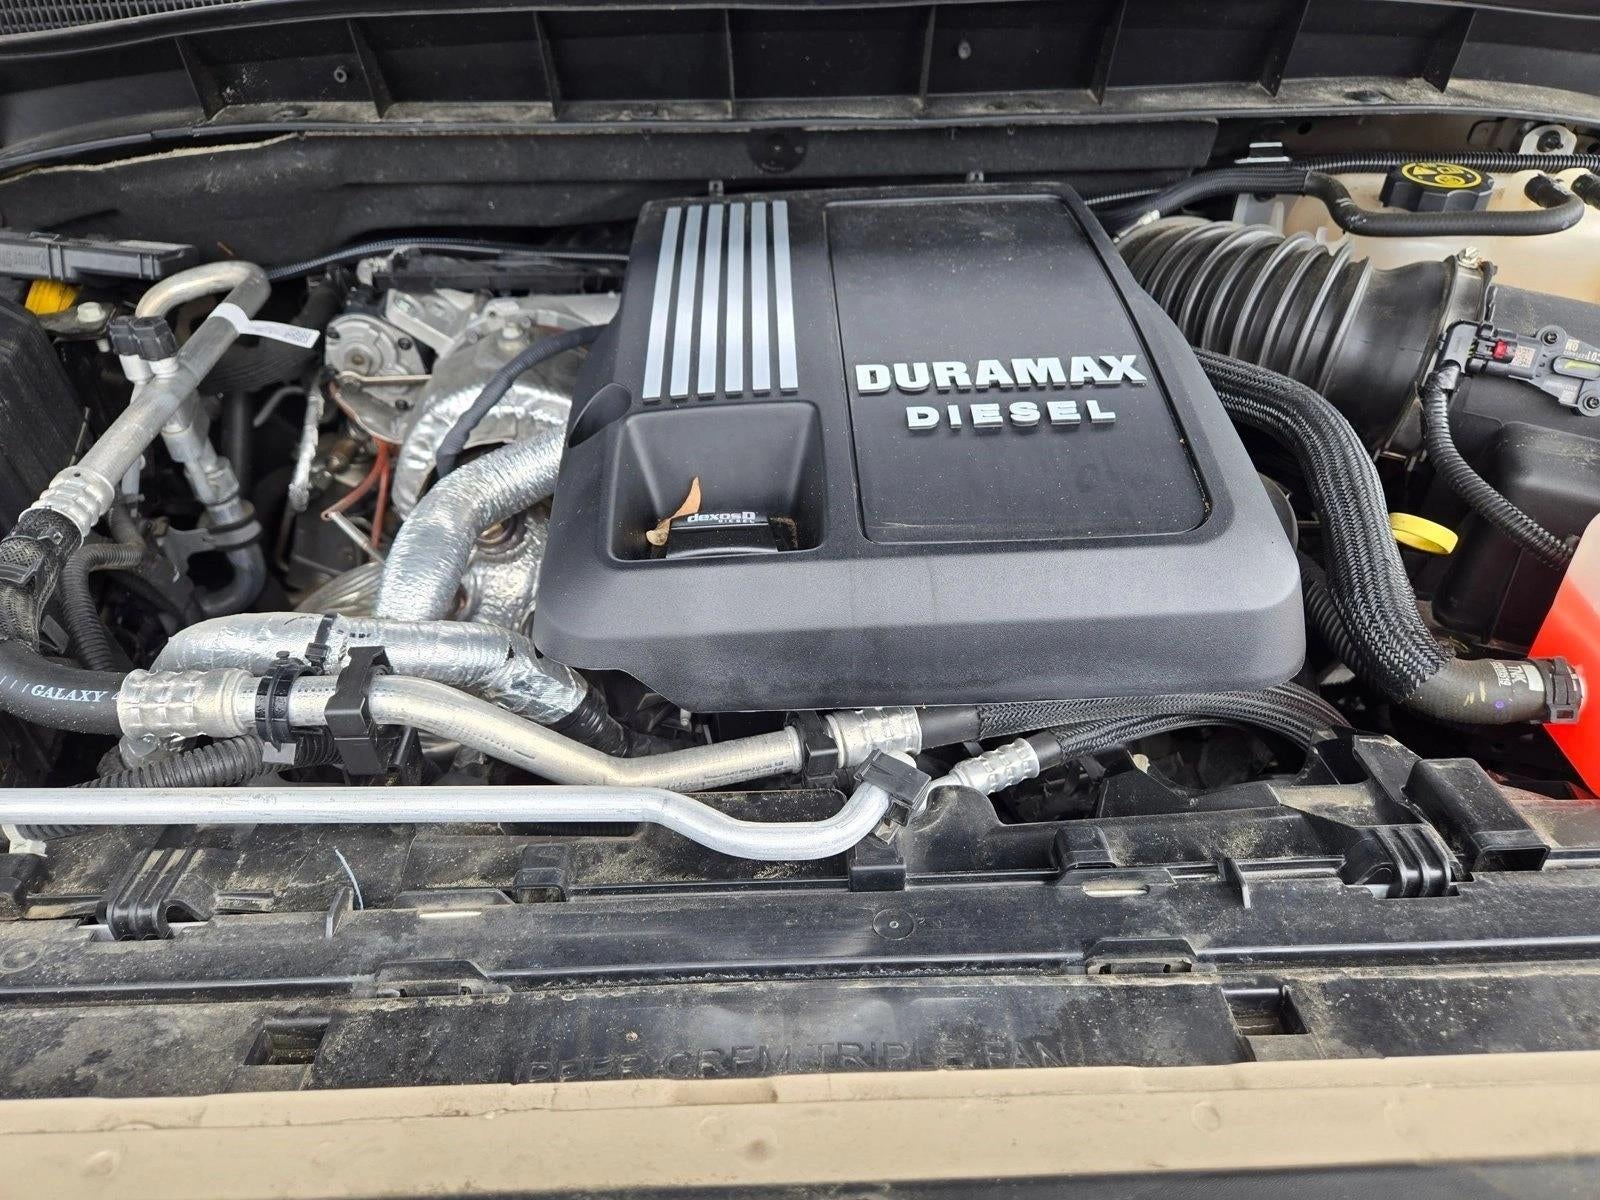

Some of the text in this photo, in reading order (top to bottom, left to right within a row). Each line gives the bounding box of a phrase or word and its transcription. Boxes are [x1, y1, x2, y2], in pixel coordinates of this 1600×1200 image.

[855, 354, 1147, 394] DURAMAX
[906, 400, 1116, 430] DIESEL
[31, 684, 108, 703] GALAXY
[807, 1041, 968, 1071] TRIPLE
[983, 1037, 1069, 1069] FAN
